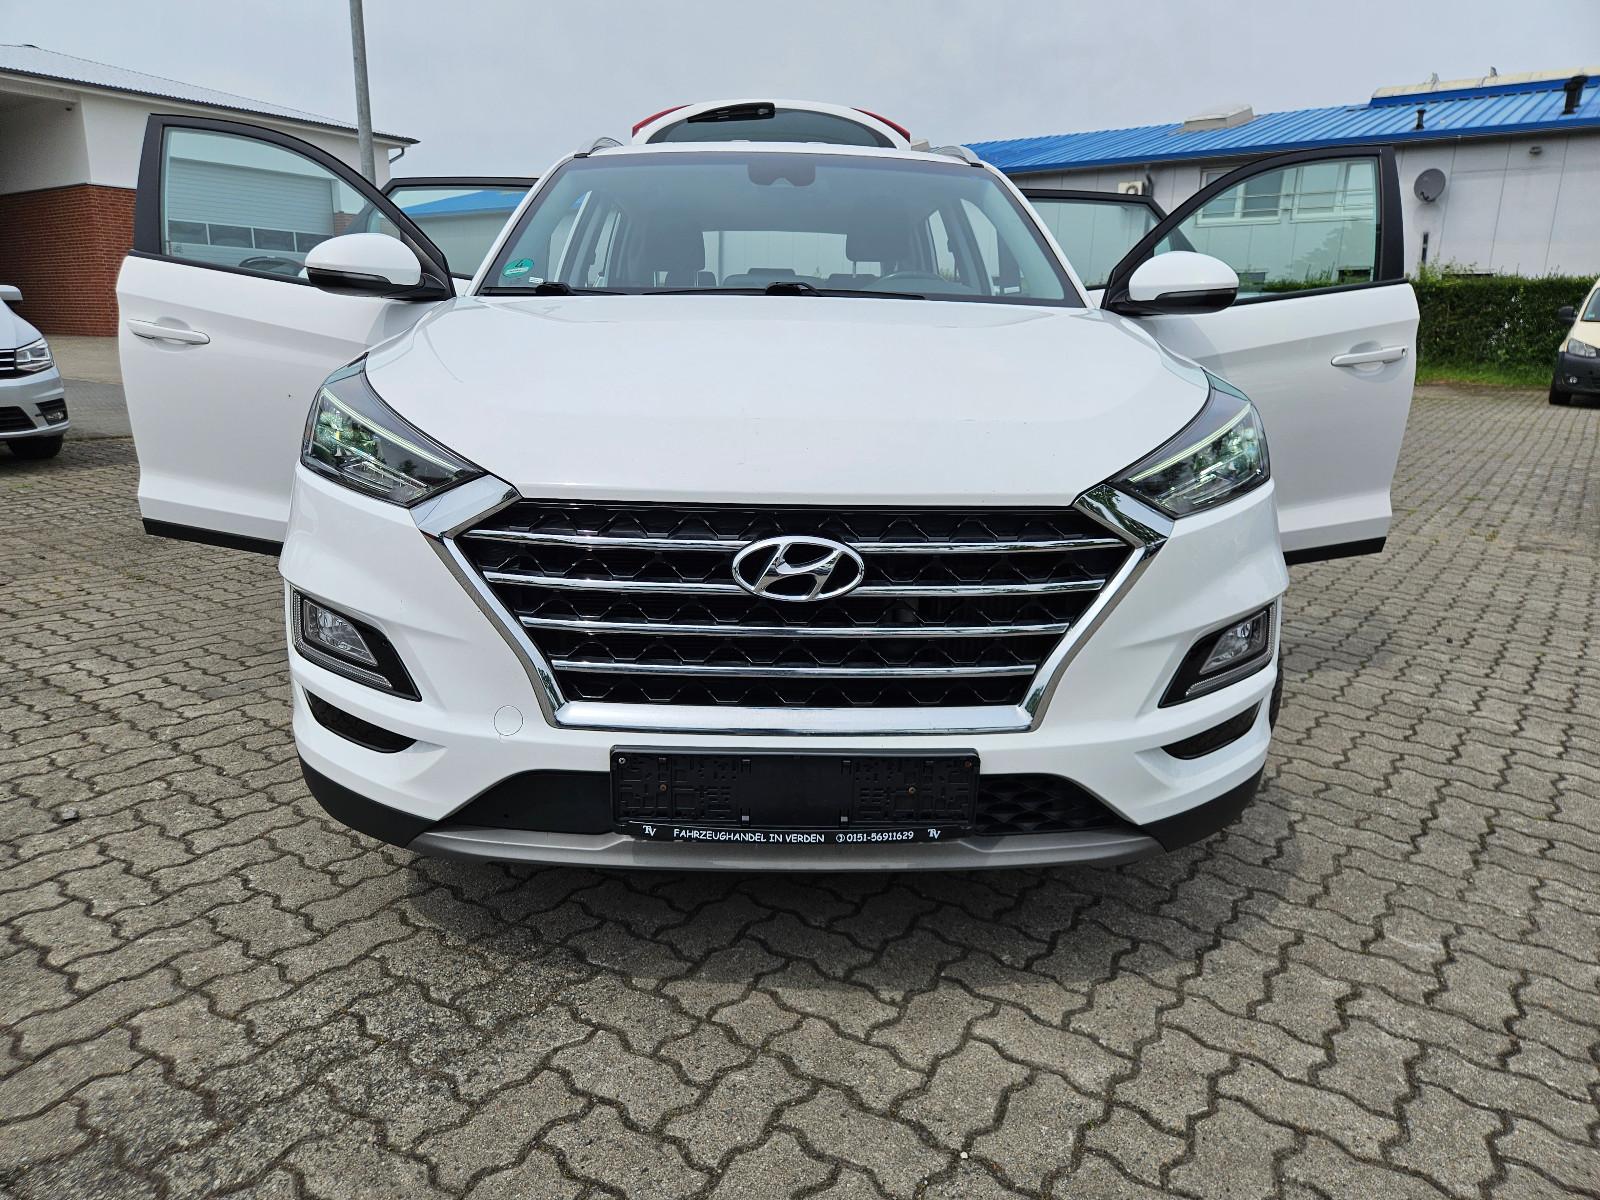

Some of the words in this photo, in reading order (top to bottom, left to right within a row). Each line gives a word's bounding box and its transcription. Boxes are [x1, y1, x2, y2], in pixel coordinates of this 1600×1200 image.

[673, 828, 767, 842] FAHRZEUGHANDEL
[769, 833, 783, 842] IN
[785, 833, 825, 843] VERDEN
[846, 831, 914, 842] 0151-56911629
